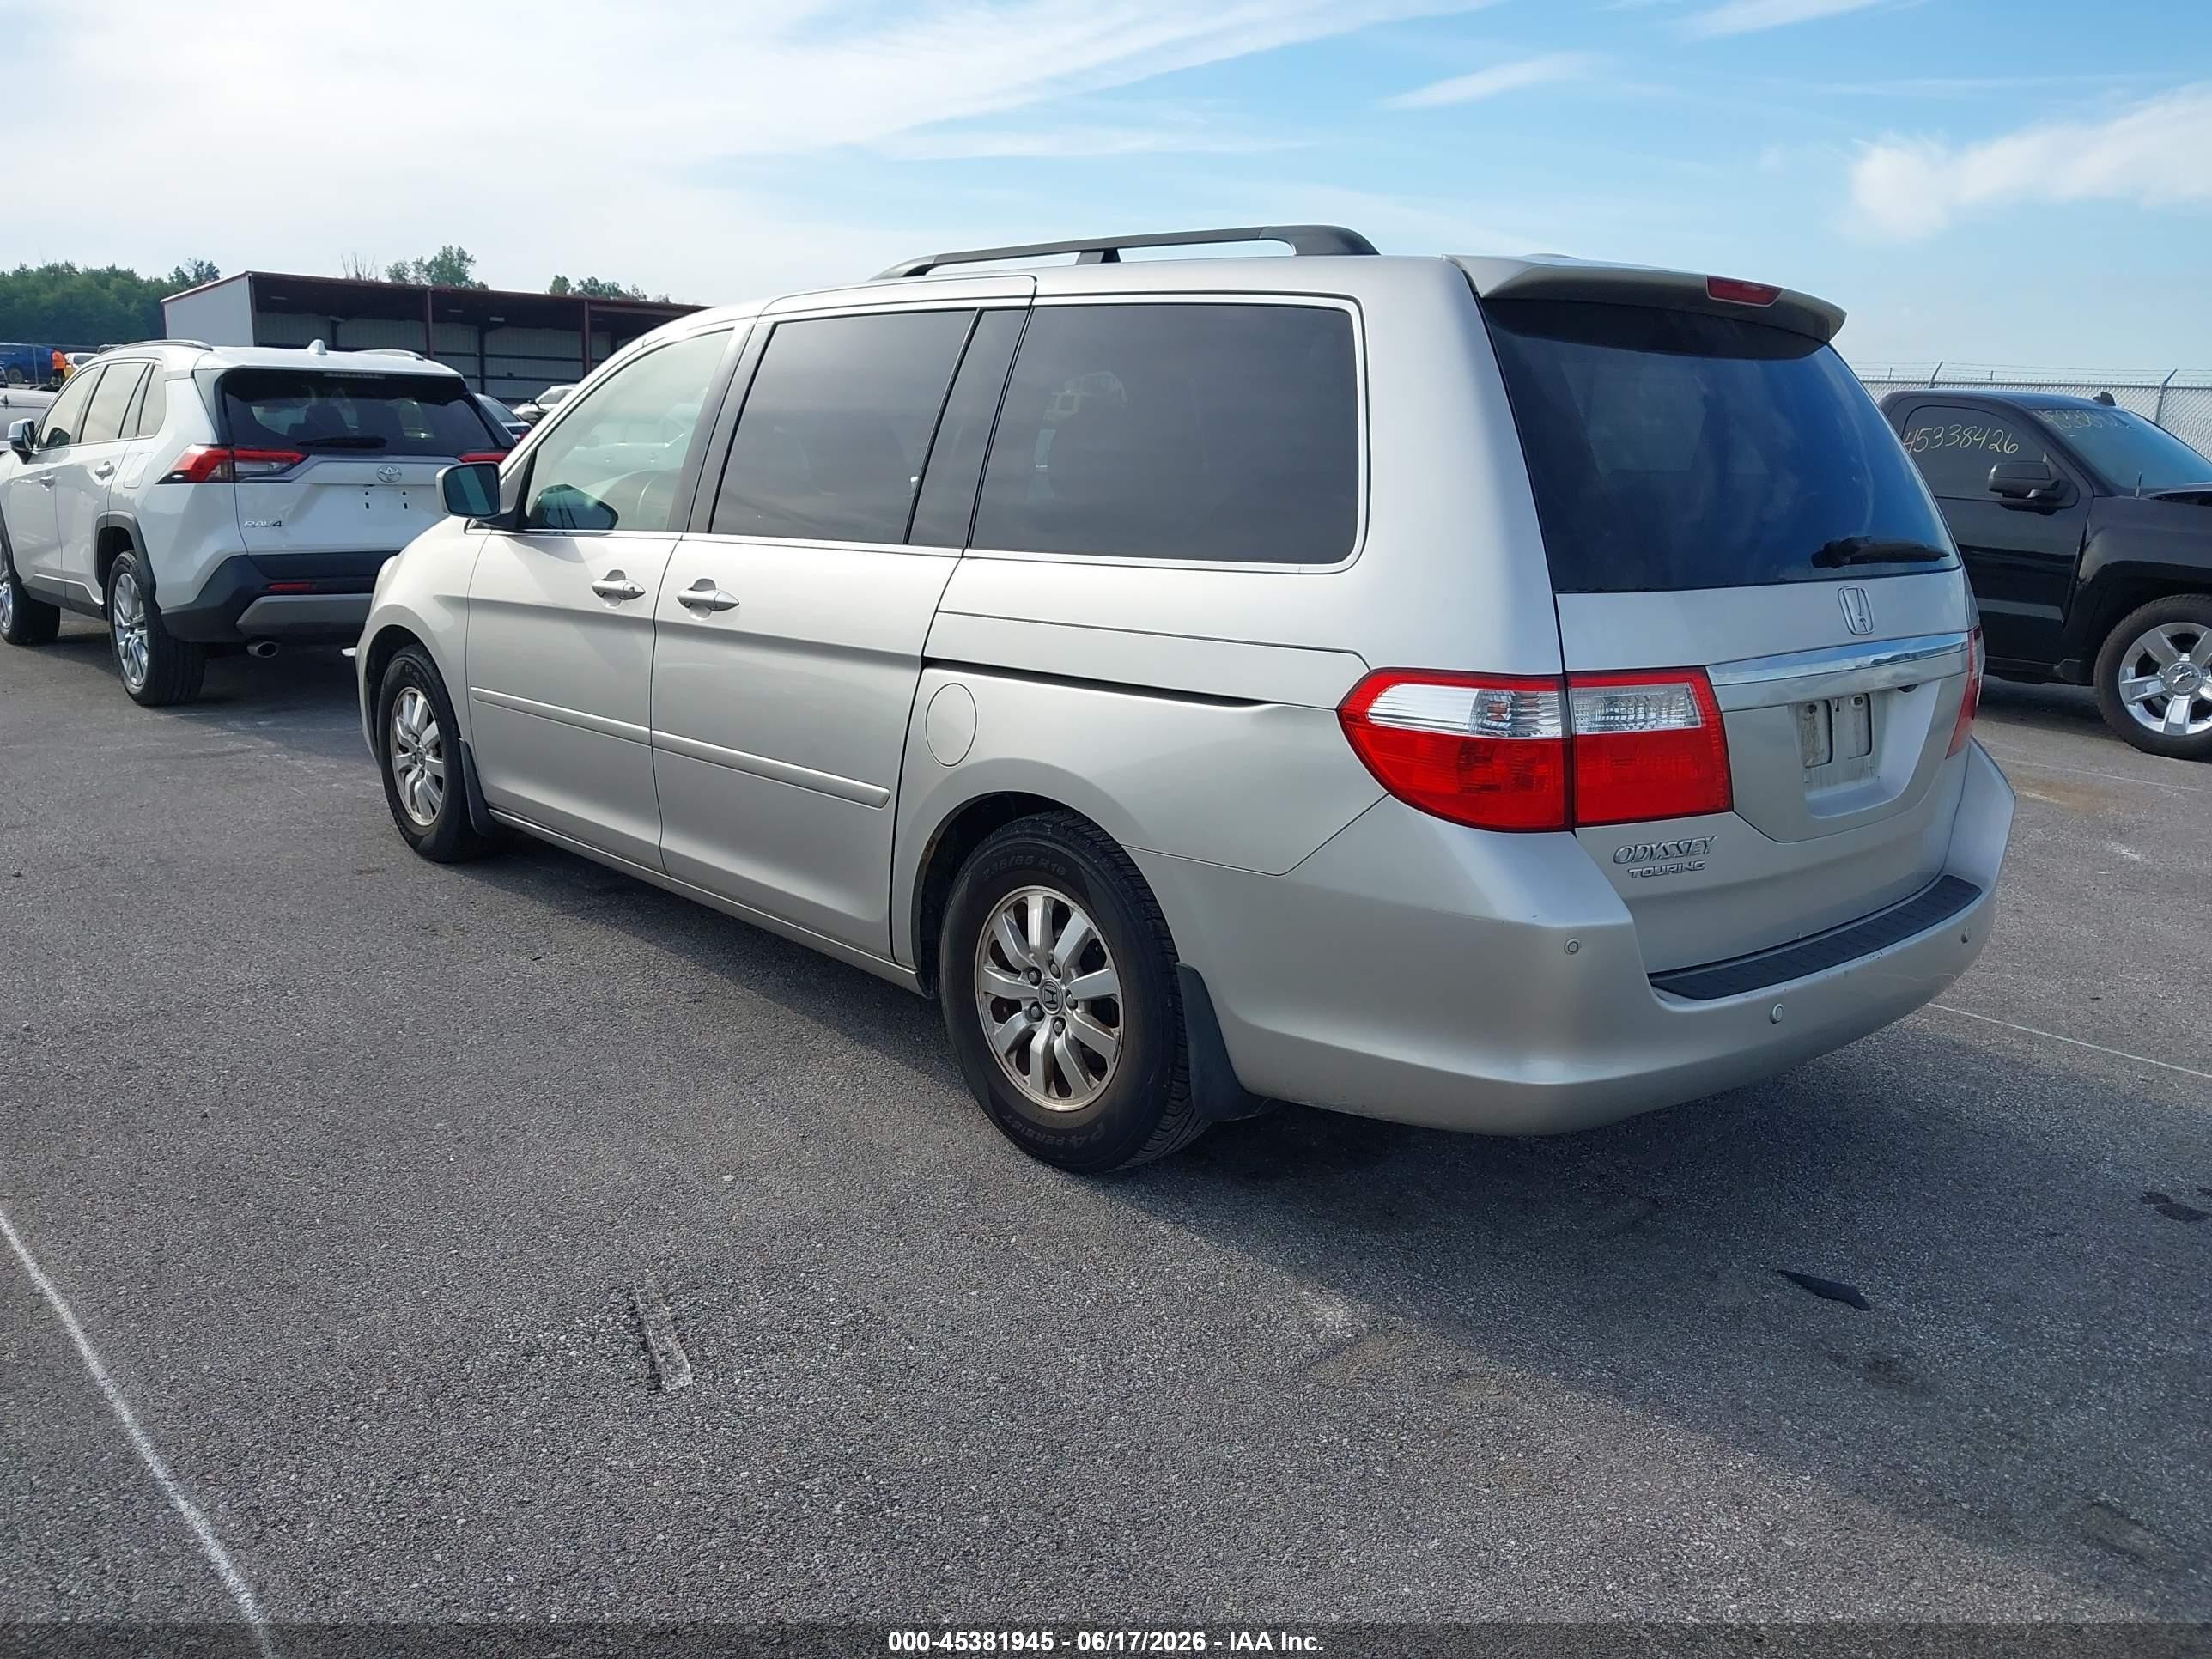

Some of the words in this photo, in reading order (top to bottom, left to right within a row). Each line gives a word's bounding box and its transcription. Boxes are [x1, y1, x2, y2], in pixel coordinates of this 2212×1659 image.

[1903, 423, 2020, 454] 45338426
[1613, 835, 1718, 865] ODYSSEY
[1627, 860, 1705, 879] TOURING
